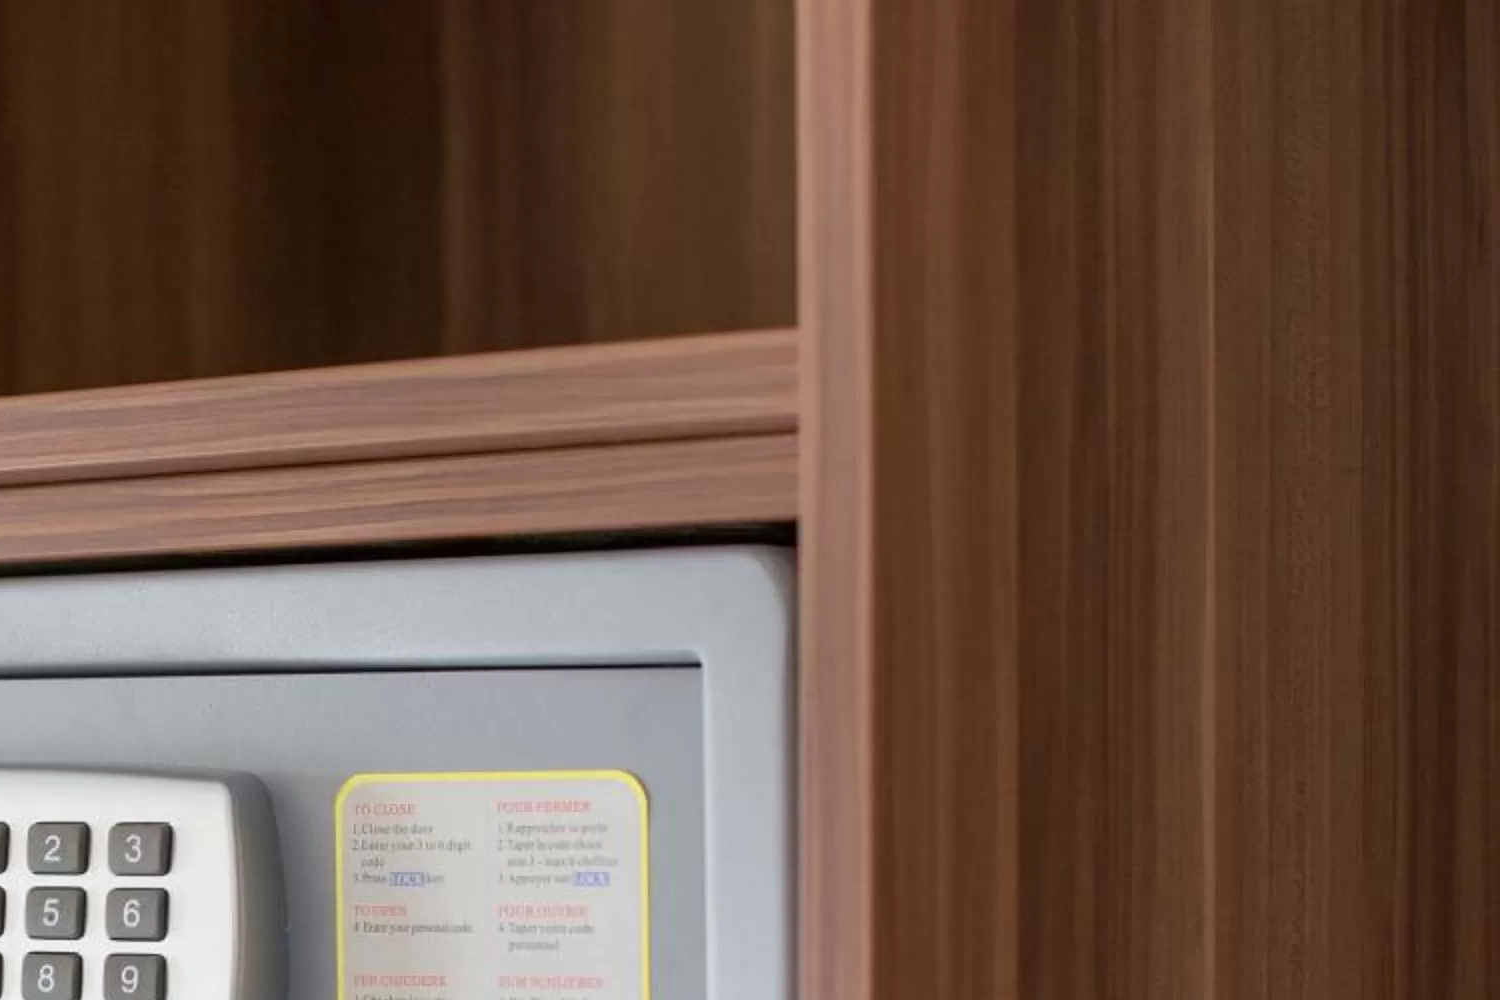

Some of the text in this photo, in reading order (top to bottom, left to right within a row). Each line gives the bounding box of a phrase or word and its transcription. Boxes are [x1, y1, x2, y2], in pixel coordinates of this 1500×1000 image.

[43, 834, 62, 863] 2
[124, 834, 142, 863] 3
[42, 898, 60, 927] 5
[122, 898, 141, 928] 6
[37, 964, 56, 993] 8
[120, 965, 139, 994] 9
